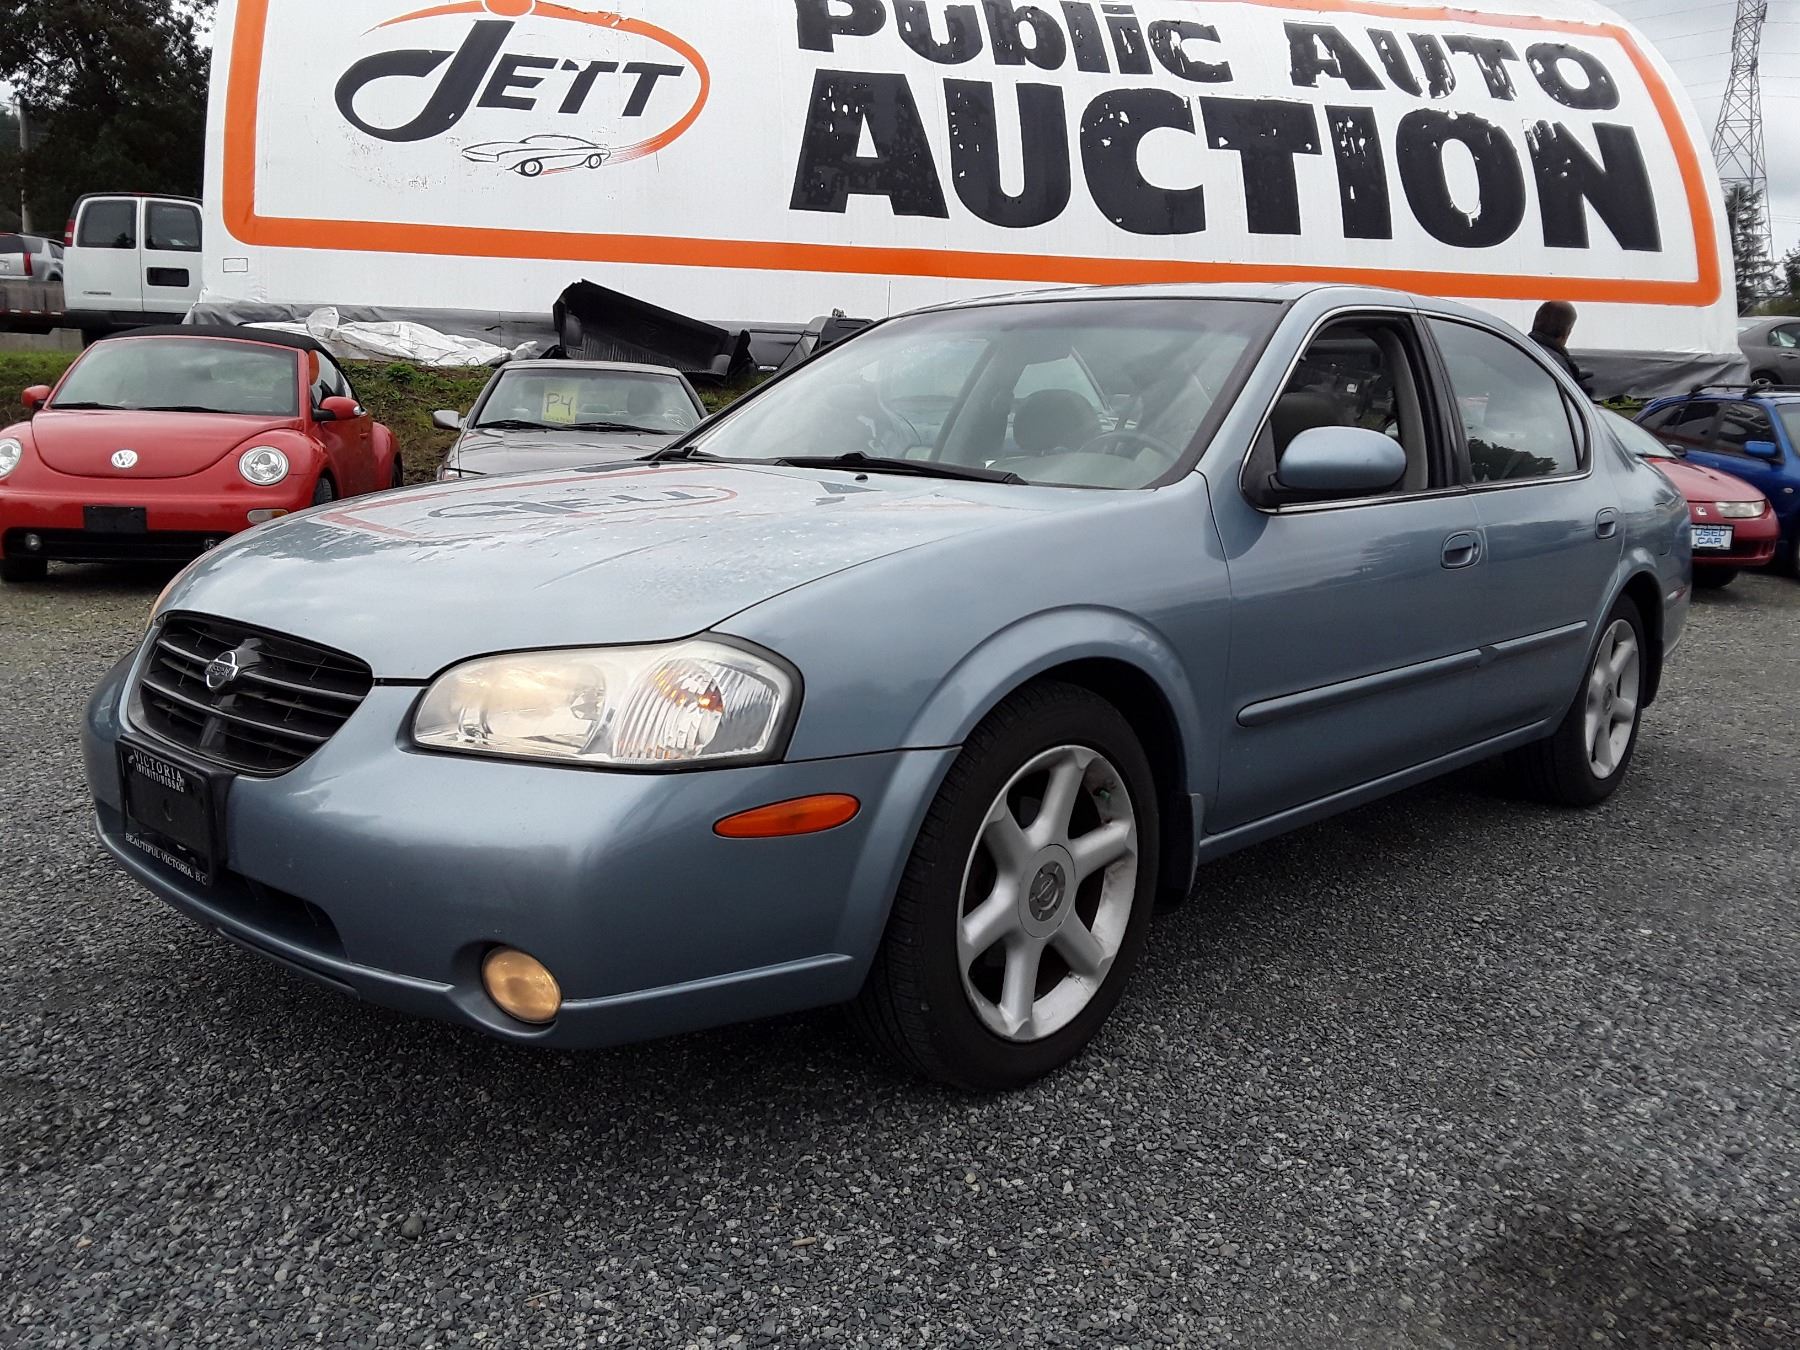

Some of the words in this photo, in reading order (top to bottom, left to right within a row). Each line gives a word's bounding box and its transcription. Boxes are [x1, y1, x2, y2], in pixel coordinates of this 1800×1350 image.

[795, 0, 1233, 83] Public
[1284, 20, 1620, 111] AUTO
[334, 18, 684, 143] JETT
[789, 68, 1663, 252] AUCTION
[546, 392, 573, 416] P4
[1695, 528, 1727, 537] USED
[1697, 537, 1722, 545] CAR
[133, 749, 183, 783] VICTORIA
[125, 832, 161, 859] BEAUTIFUL
